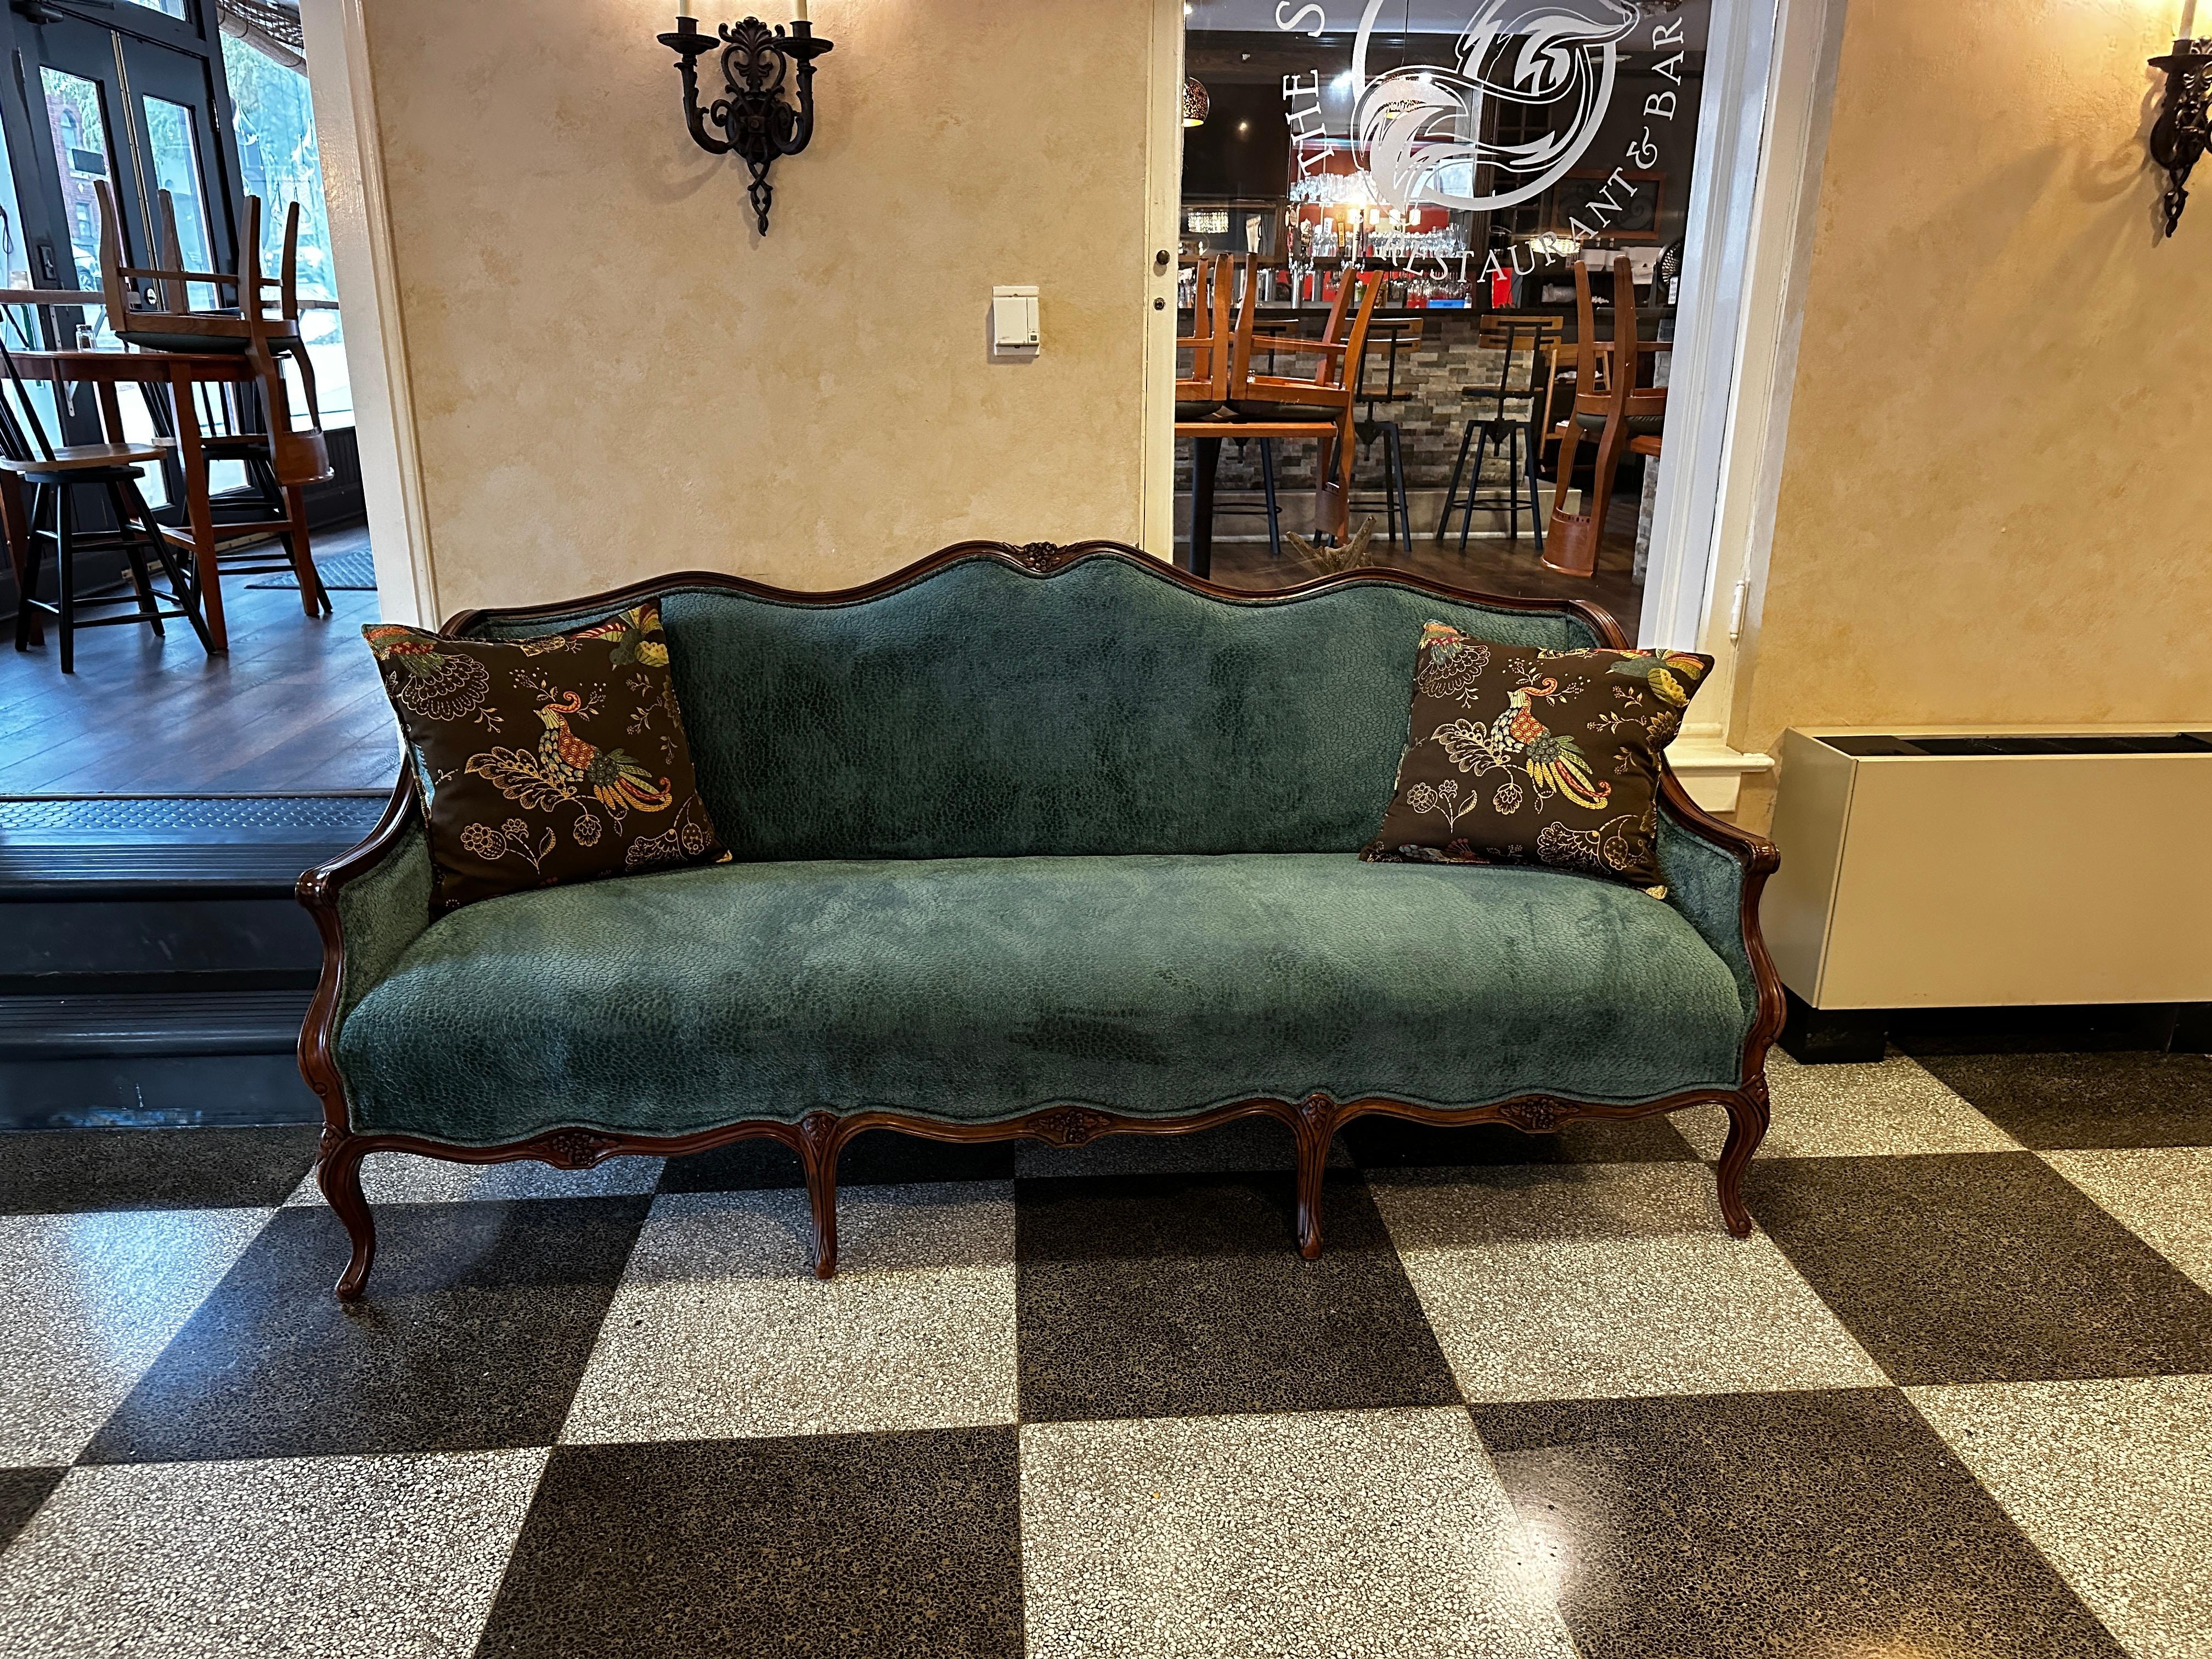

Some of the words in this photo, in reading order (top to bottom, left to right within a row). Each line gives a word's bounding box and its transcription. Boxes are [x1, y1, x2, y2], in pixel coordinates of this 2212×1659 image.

[1283, 69, 1335, 176] THE
[1376, 166, 1638, 284] RESTAURANT
[1626, 126, 1658, 170] &
[1643, 16, 1684, 121] BAR
